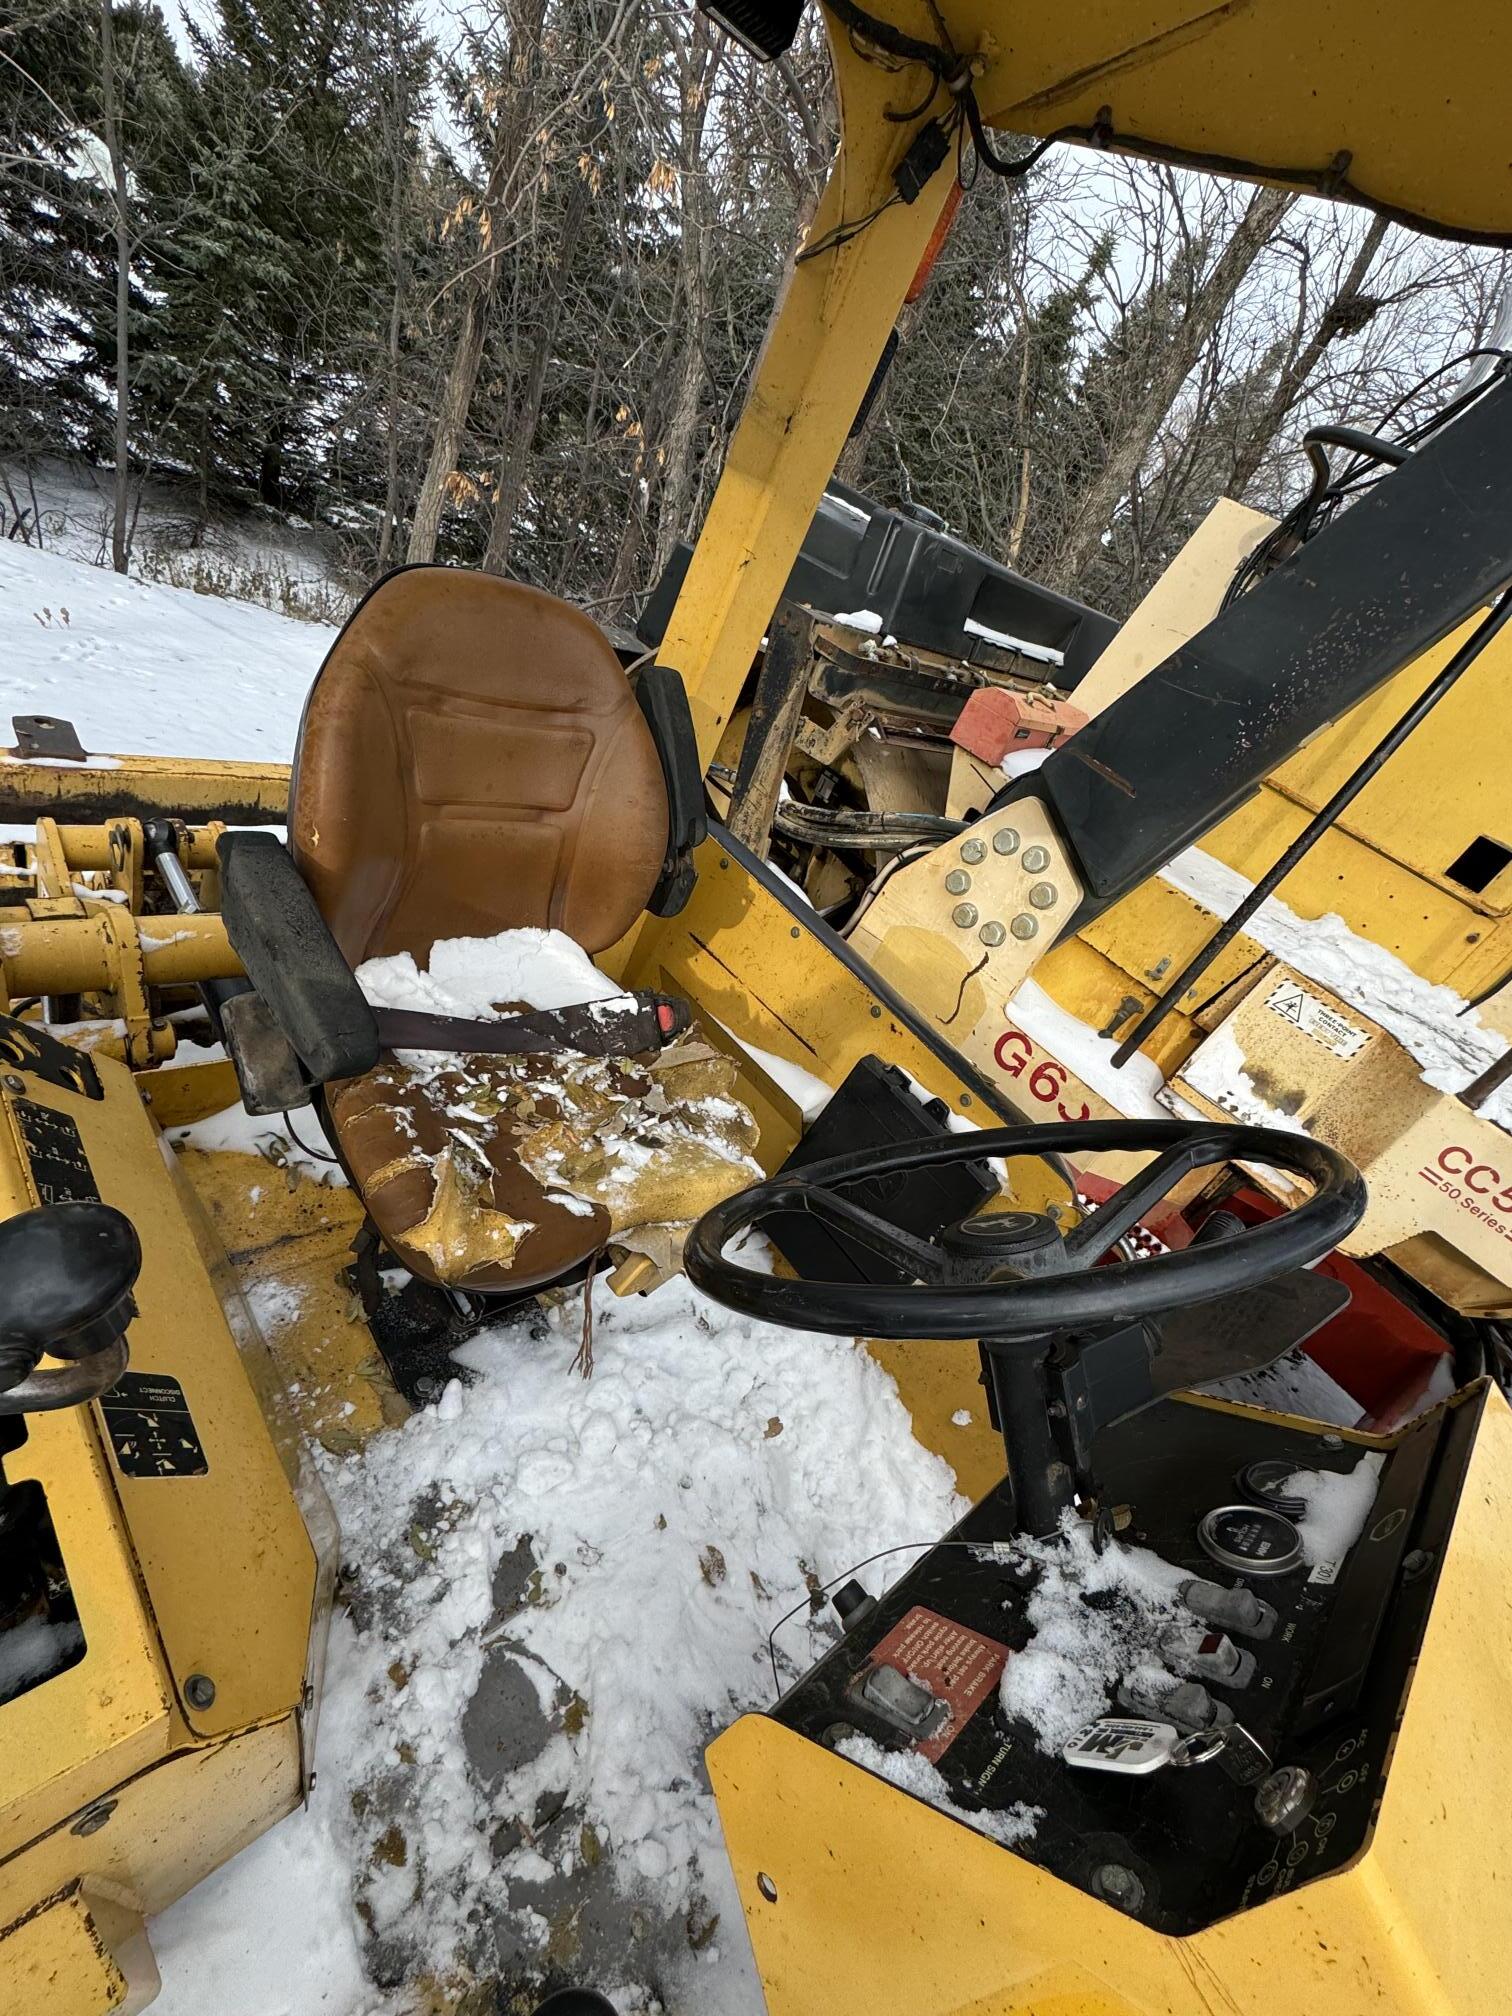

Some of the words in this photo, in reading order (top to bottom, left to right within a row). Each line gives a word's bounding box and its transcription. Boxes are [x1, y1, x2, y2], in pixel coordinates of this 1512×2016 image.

[1317, 1009, 1358, 1037] THREE-POINT
[1319, 1017, 1347, 1037] CONTACT
[1439, 1182, 1461, 1199] 50
[1460, 1197, 1507, 1234] Series
[138, 1383, 180, 1399] DISCONNECT
[148, 1392, 176, 1404] CLUTCH
[1283, 1622, 1295, 1642] WORK
[964, 1671, 984, 1696] BRAKE
[1261, 1676, 1273, 1690] ON
[991, 1742, 1011, 1767] TURN
